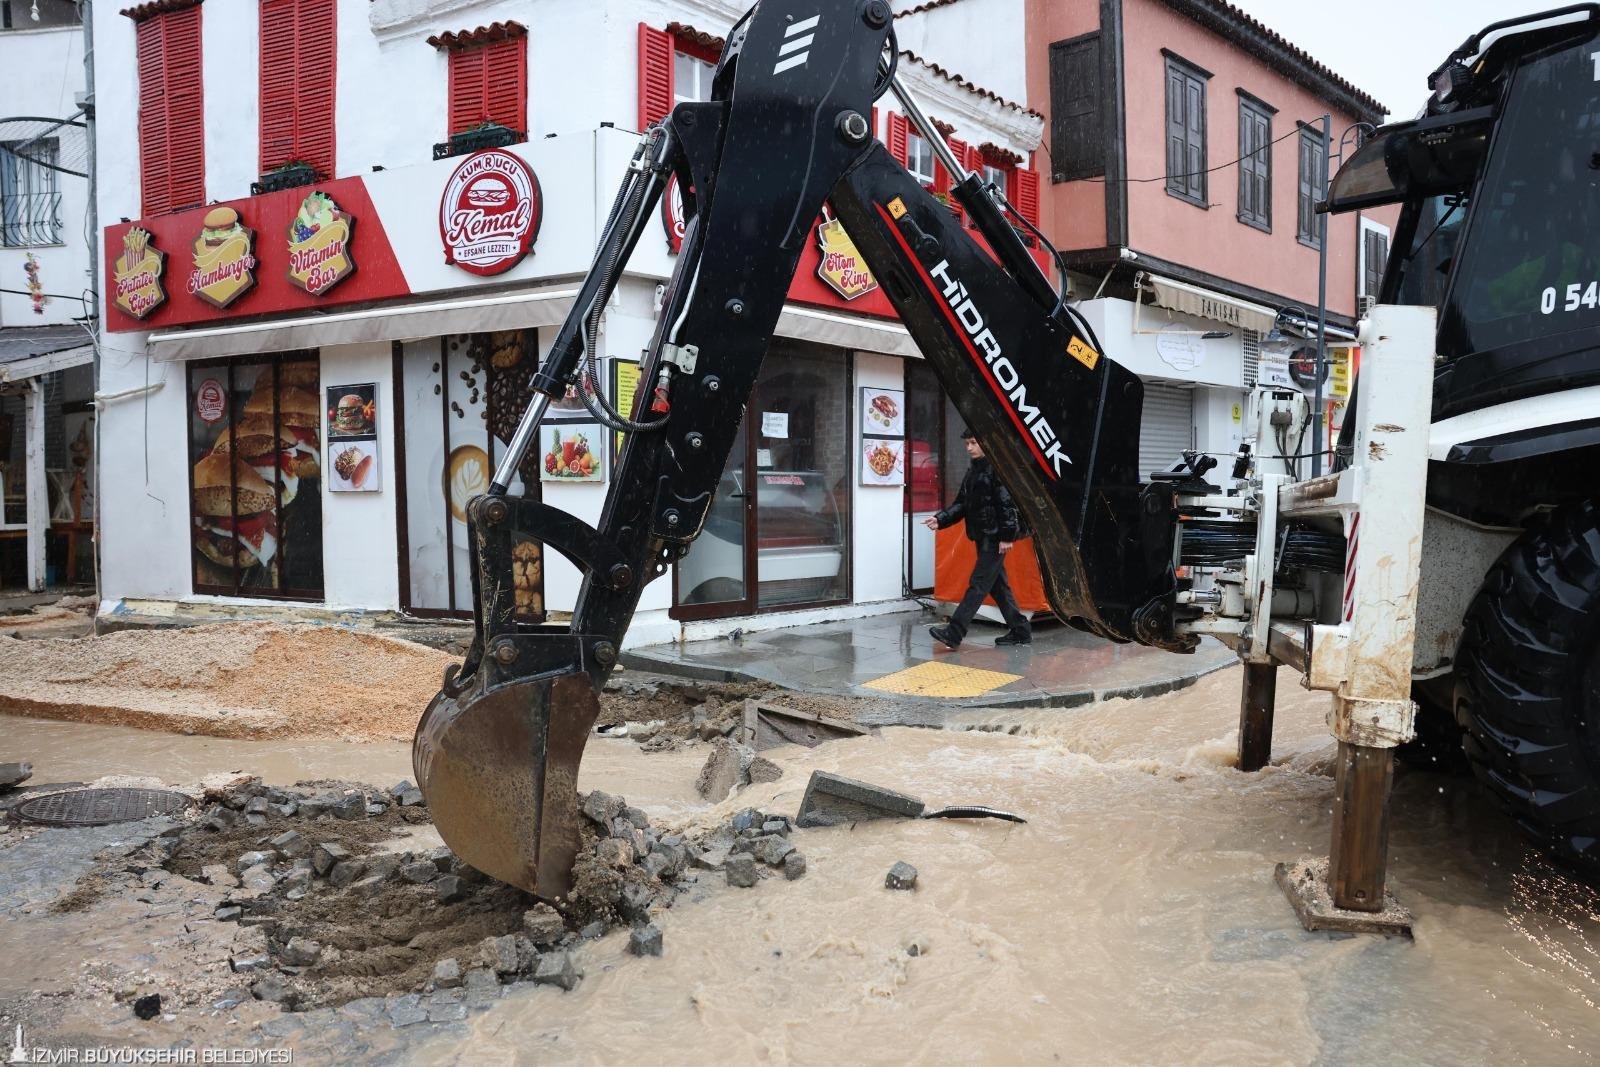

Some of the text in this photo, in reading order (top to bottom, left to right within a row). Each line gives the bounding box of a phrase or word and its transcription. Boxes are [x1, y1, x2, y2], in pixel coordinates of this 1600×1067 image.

[460, 157, 517, 182] KUMRUCU
[448, 200, 528, 242] Kemal
[290, 239, 344, 274] Vitamin
[464, 244, 511, 258] EFSANE LEZZET!
[826, 252, 856, 272] Atom
[117, 271, 154, 297] Patates
[187, 255, 255, 293] Hamburger
[306, 266, 336, 291] Bar
[840, 269, 868, 290] King
[1541, 281, 1600, 315] 0 54
